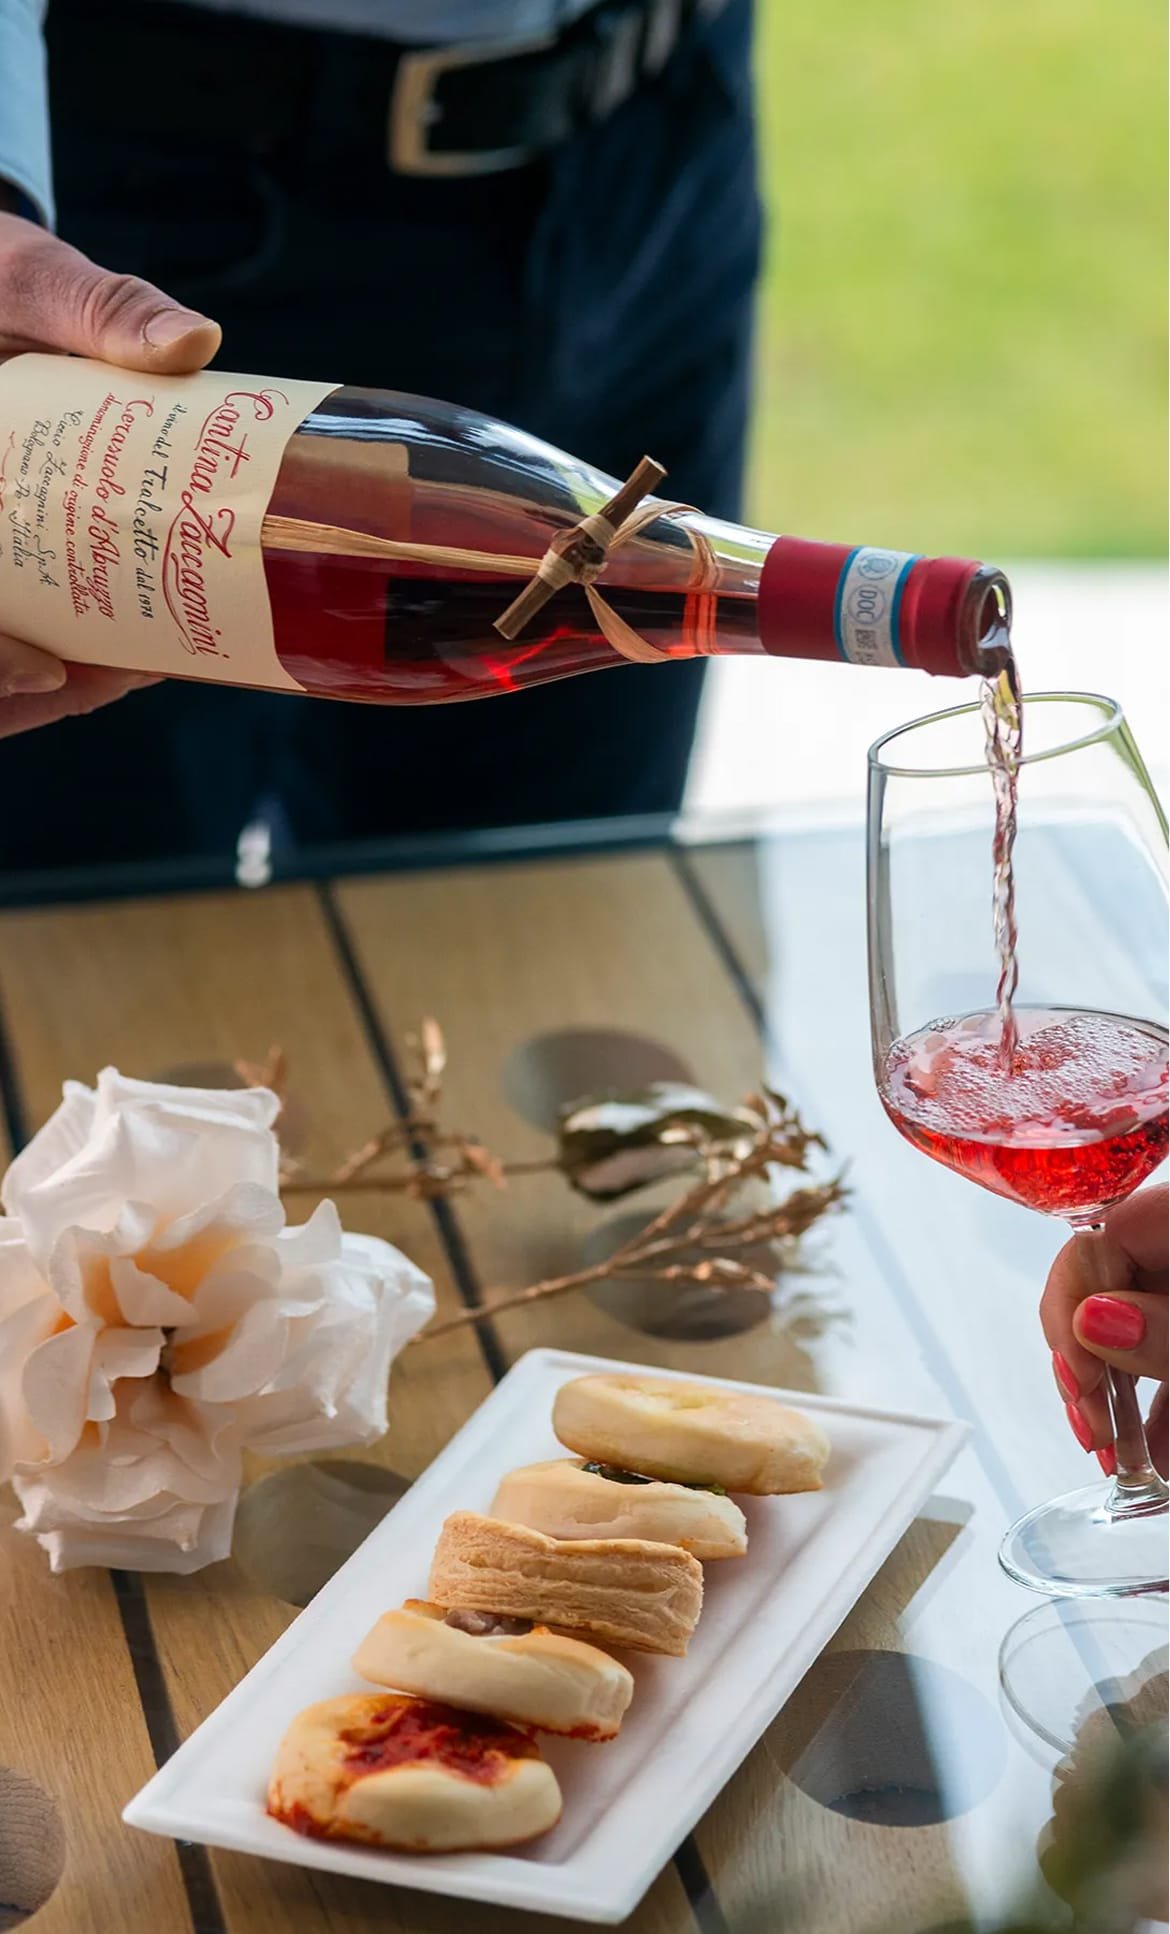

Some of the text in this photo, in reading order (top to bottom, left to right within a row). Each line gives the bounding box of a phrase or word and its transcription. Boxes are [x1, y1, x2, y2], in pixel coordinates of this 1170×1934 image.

[20, 420, 51, 475] Bolognano
[52, 410, 84, 447] Ciccio
[34, 451, 67, 532] Zaccagnini
[62, 393, 122, 617] denominazione di origine controllata
[86, 396, 154, 620] Cerasuolo d'Abruzzo
[133, 403, 187, 619] il vino del Tralcetto dal 1978
[163, 389, 289, 658] Cantina Zaccagnini
[8, 510, 33, 568] Italia
[857, 590, 877, 619] DOC
